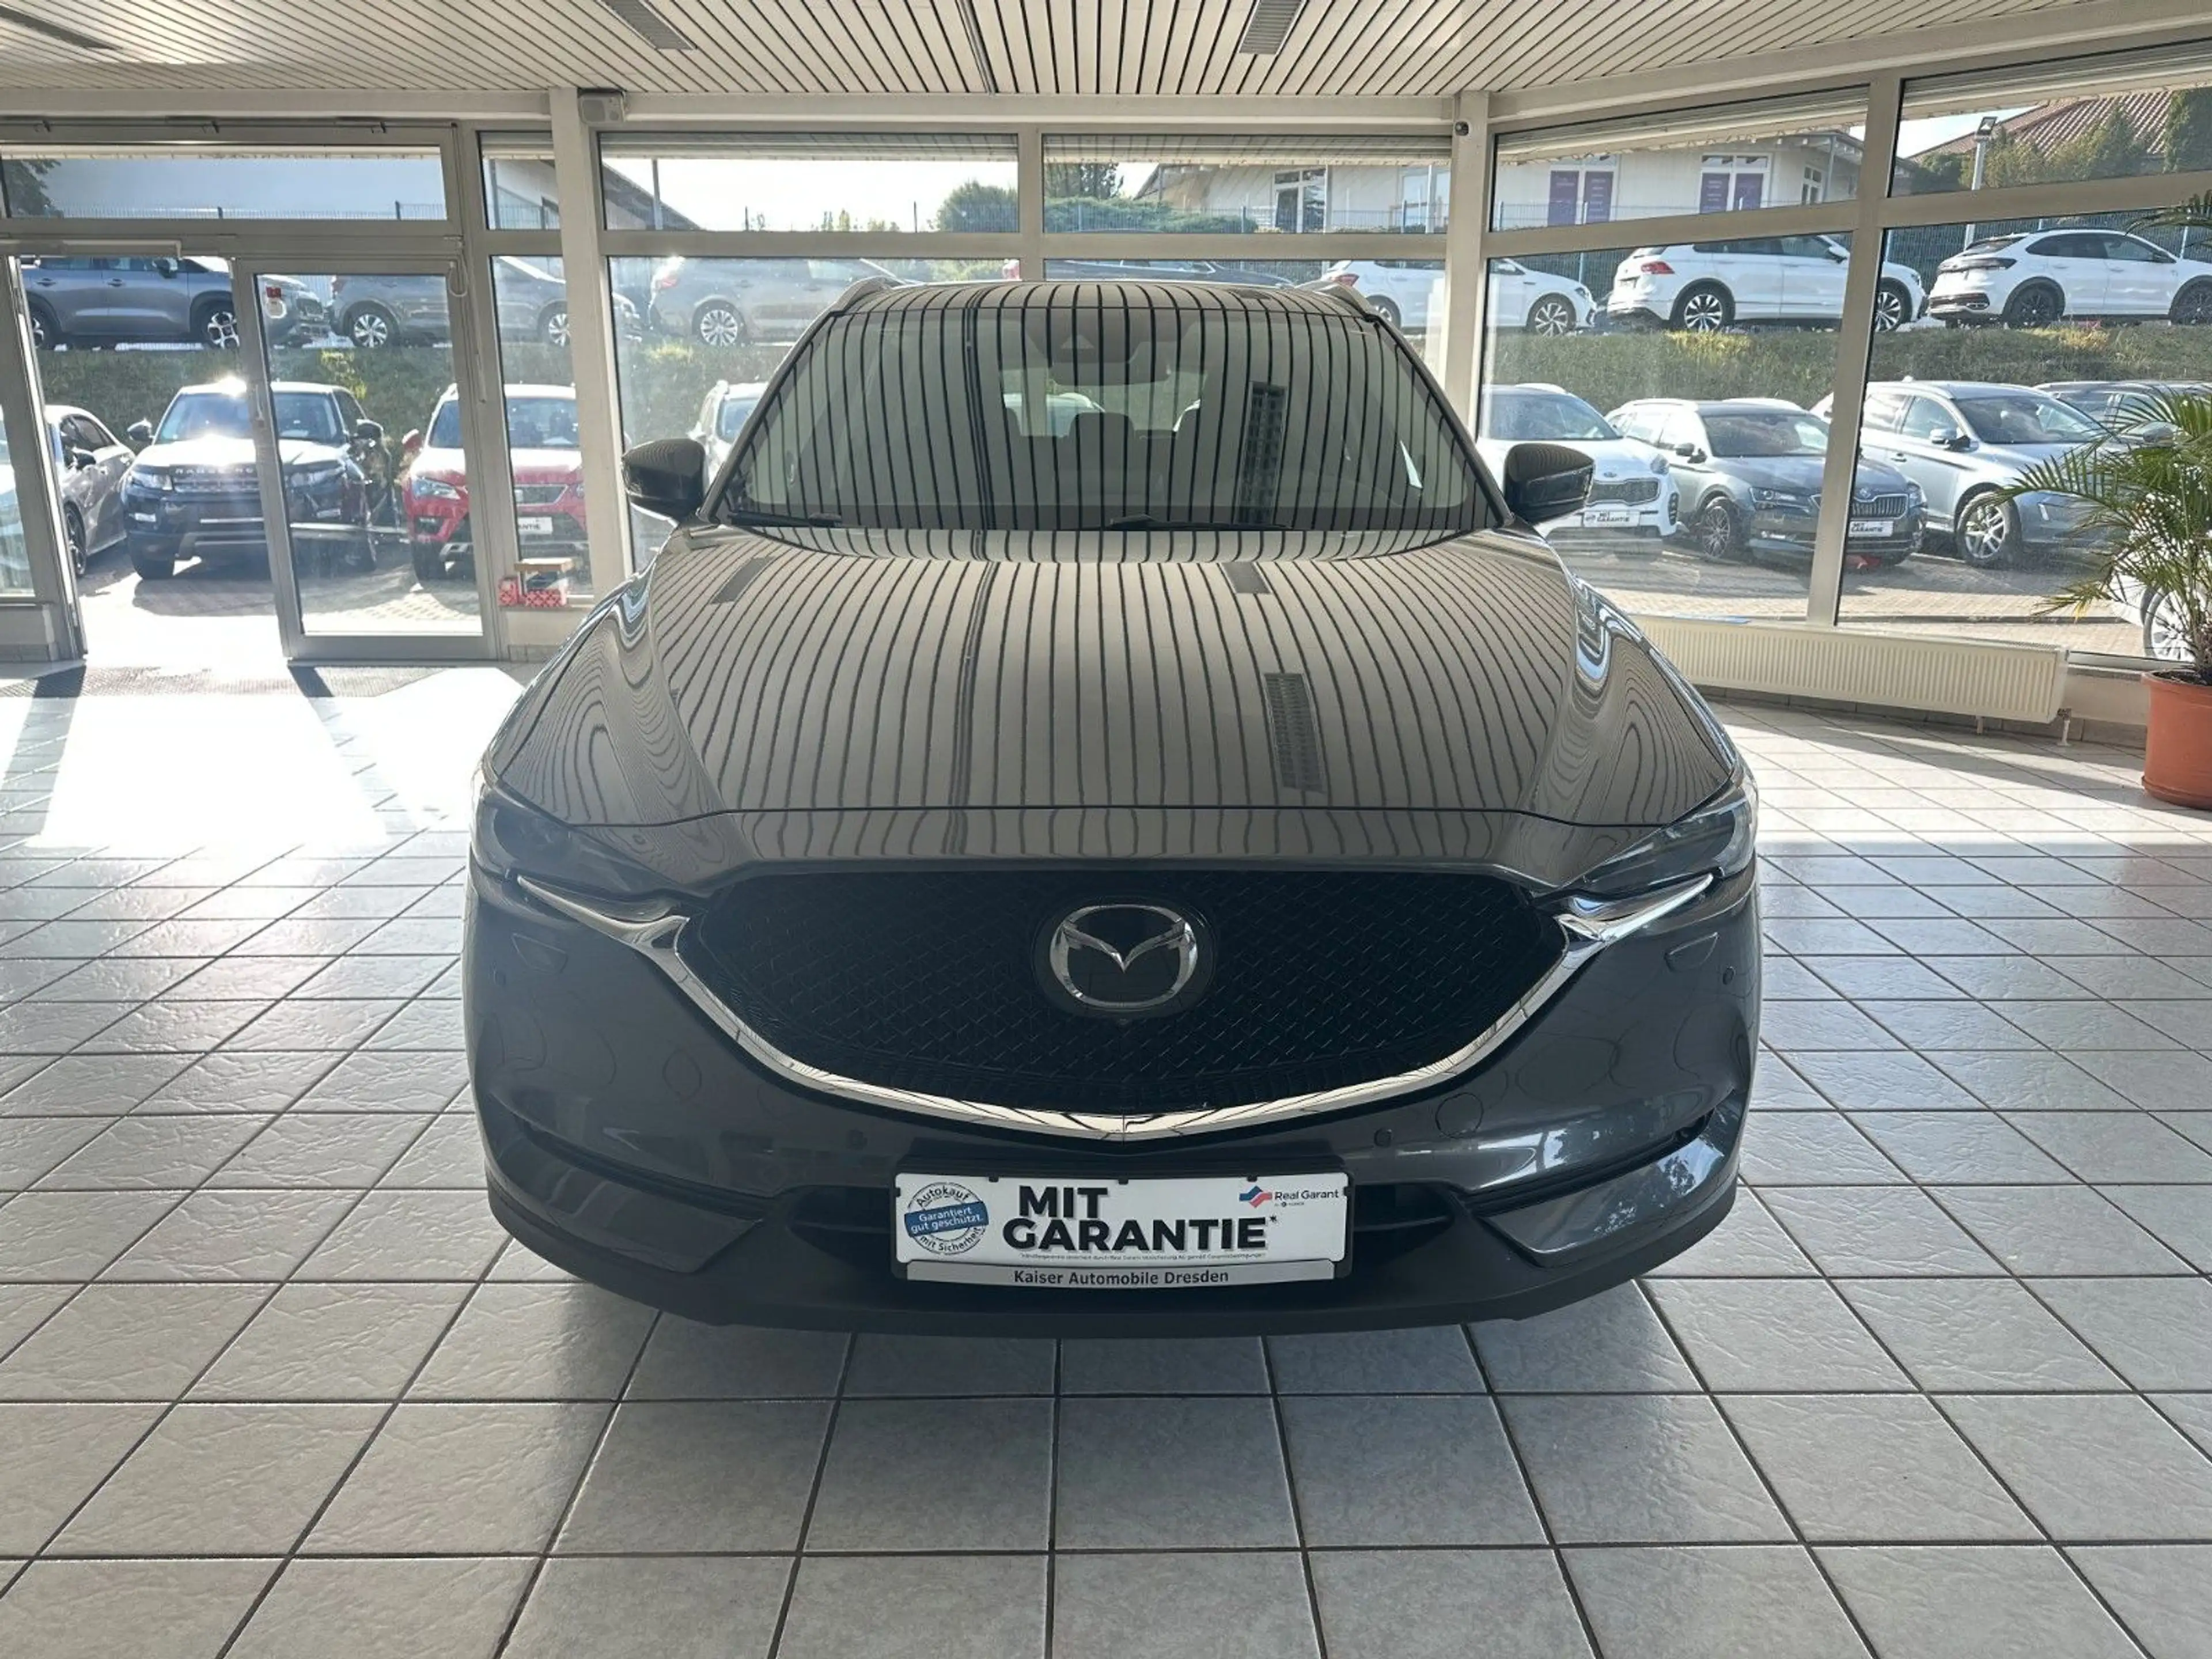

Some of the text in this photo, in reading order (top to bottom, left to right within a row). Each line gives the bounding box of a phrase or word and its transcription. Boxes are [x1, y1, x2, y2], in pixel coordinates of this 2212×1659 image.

[916, 1185, 969, 1208] Autokauf
[1019, 1185, 1108, 1218] MIT
[1274, 1189, 1339, 1200] Real Garant
[919, 1207, 973, 1222] Garantiert
[911, 1221, 929, 1234] gut
[921, 1227, 982, 1252] mit Sicherheit
[1014, 1269, 1229, 1285] Kaiser Automobile Dresden
